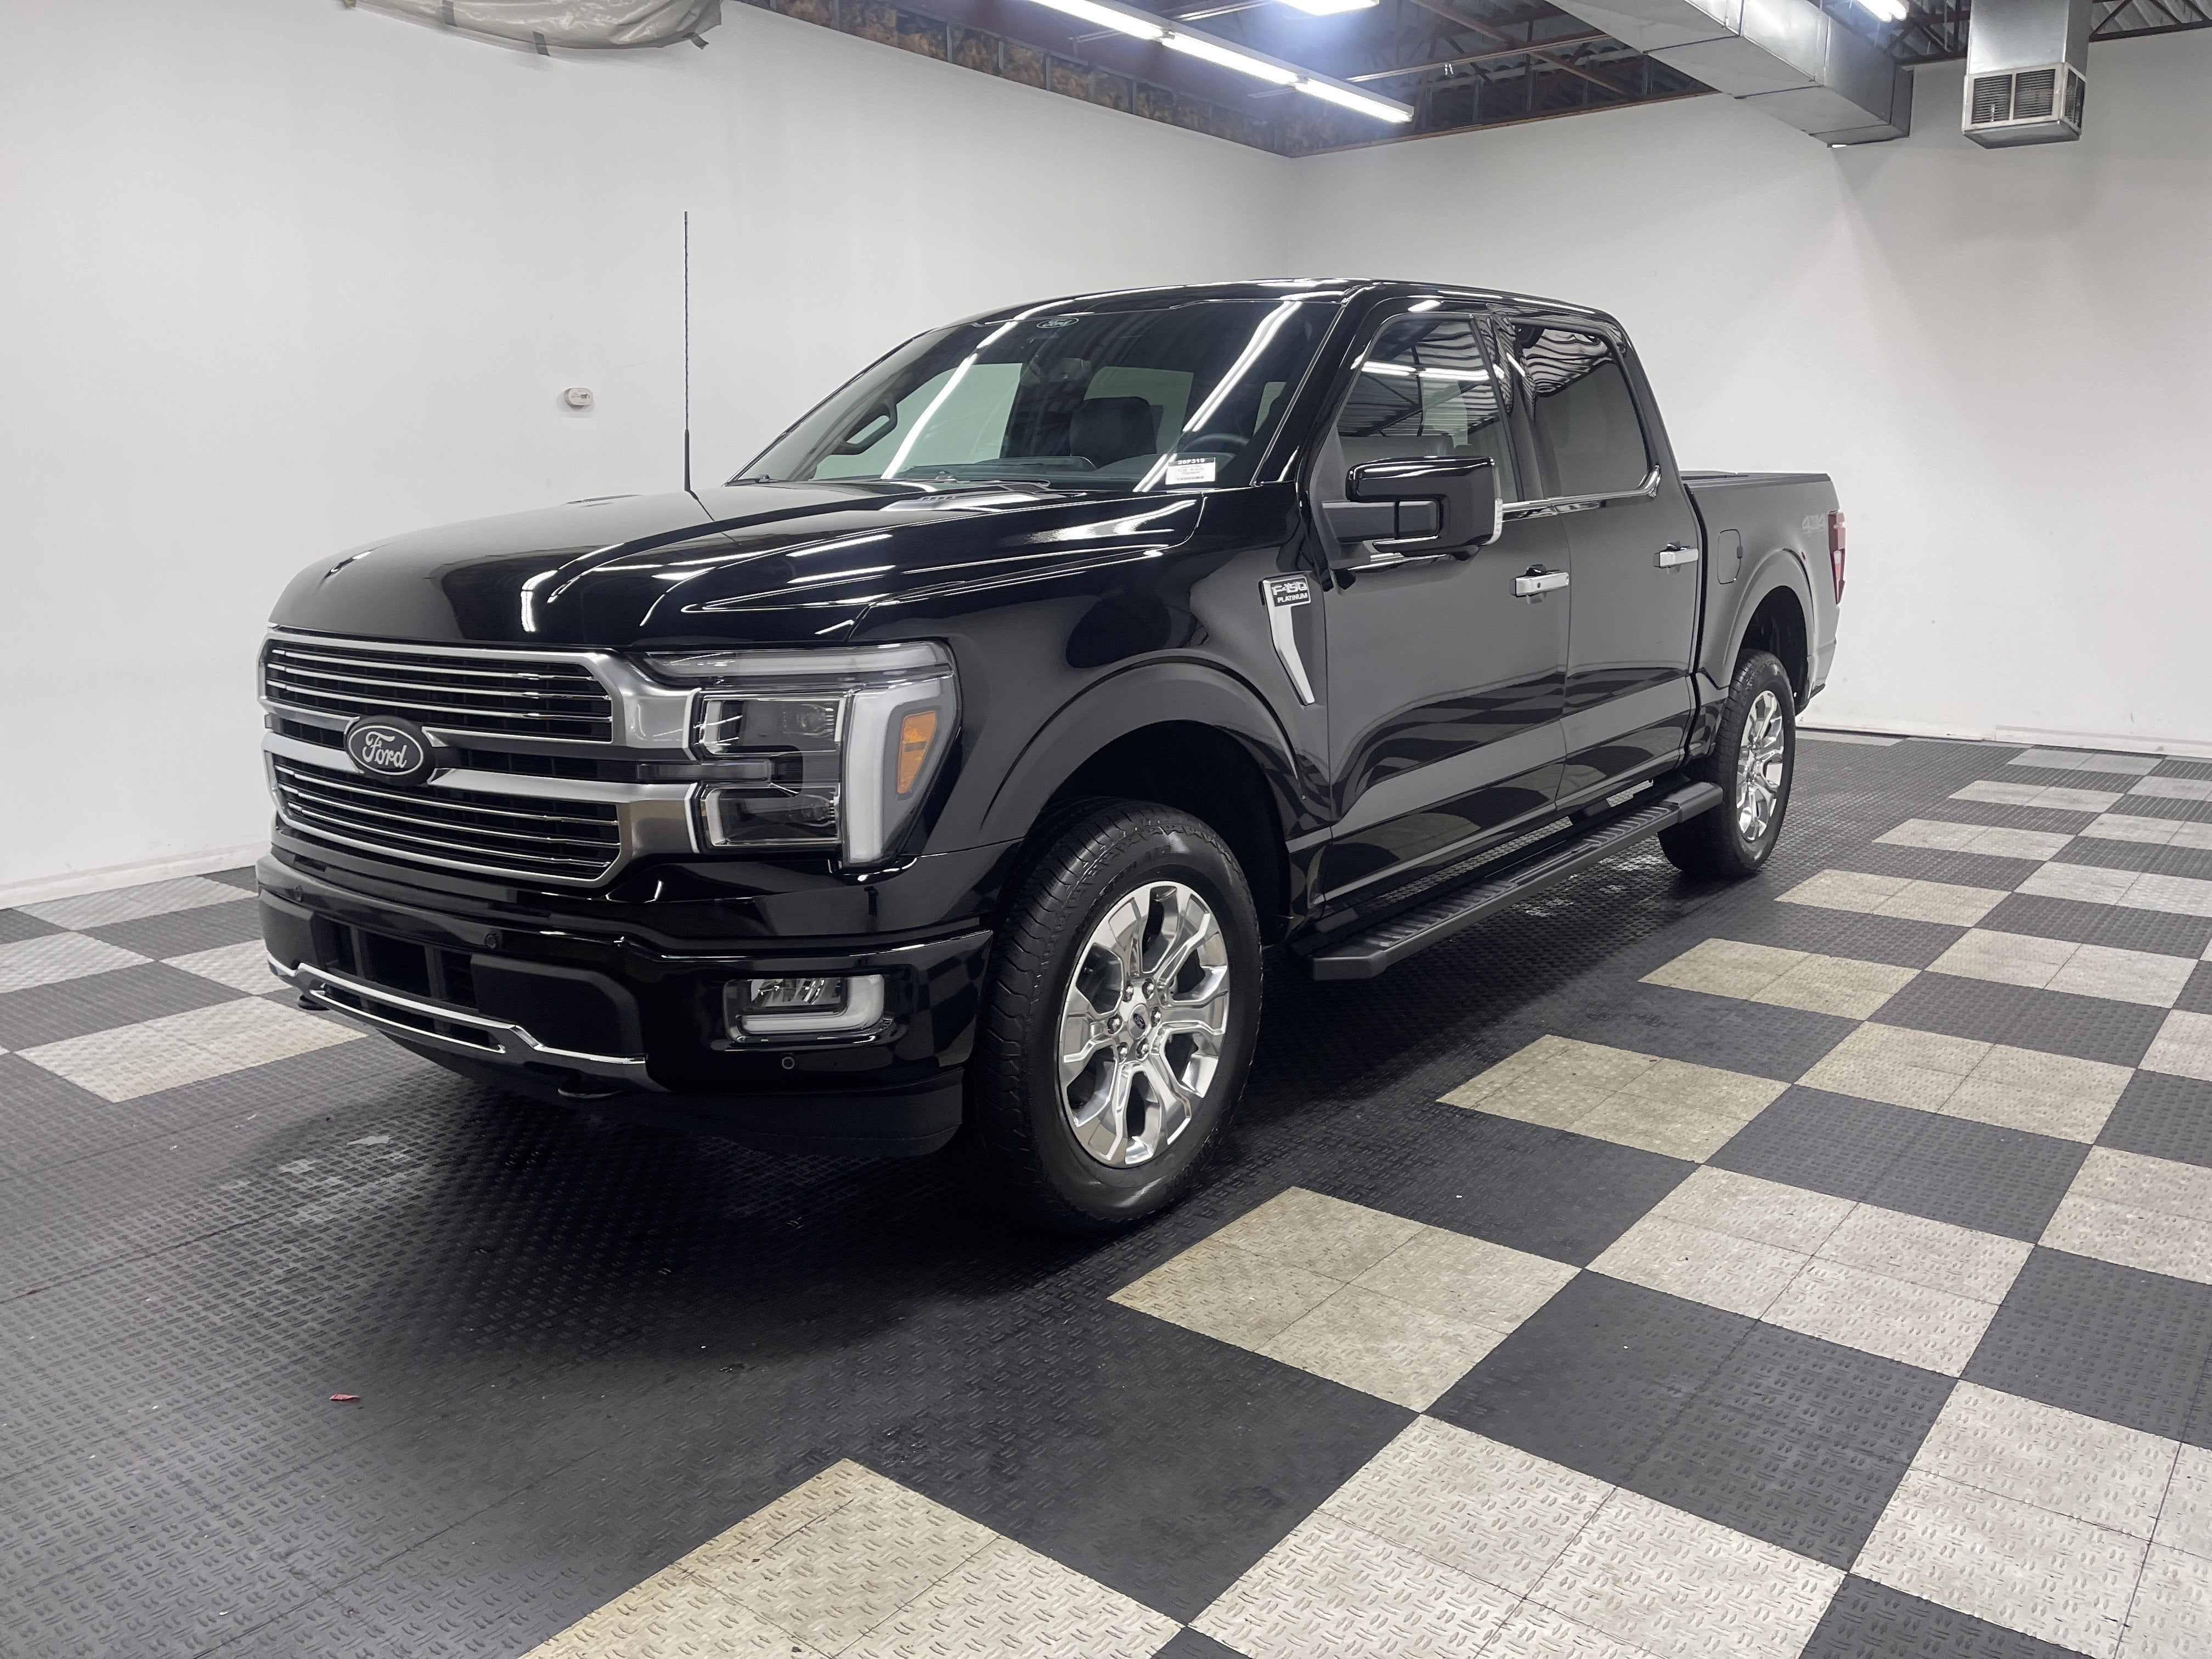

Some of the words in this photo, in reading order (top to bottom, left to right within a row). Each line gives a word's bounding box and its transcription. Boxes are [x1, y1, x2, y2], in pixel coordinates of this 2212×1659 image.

[1271, 581, 1307, 596] F-150
[1277, 592, 1308, 603] PLATINUM
[362, 731, 407, 768] Ford
